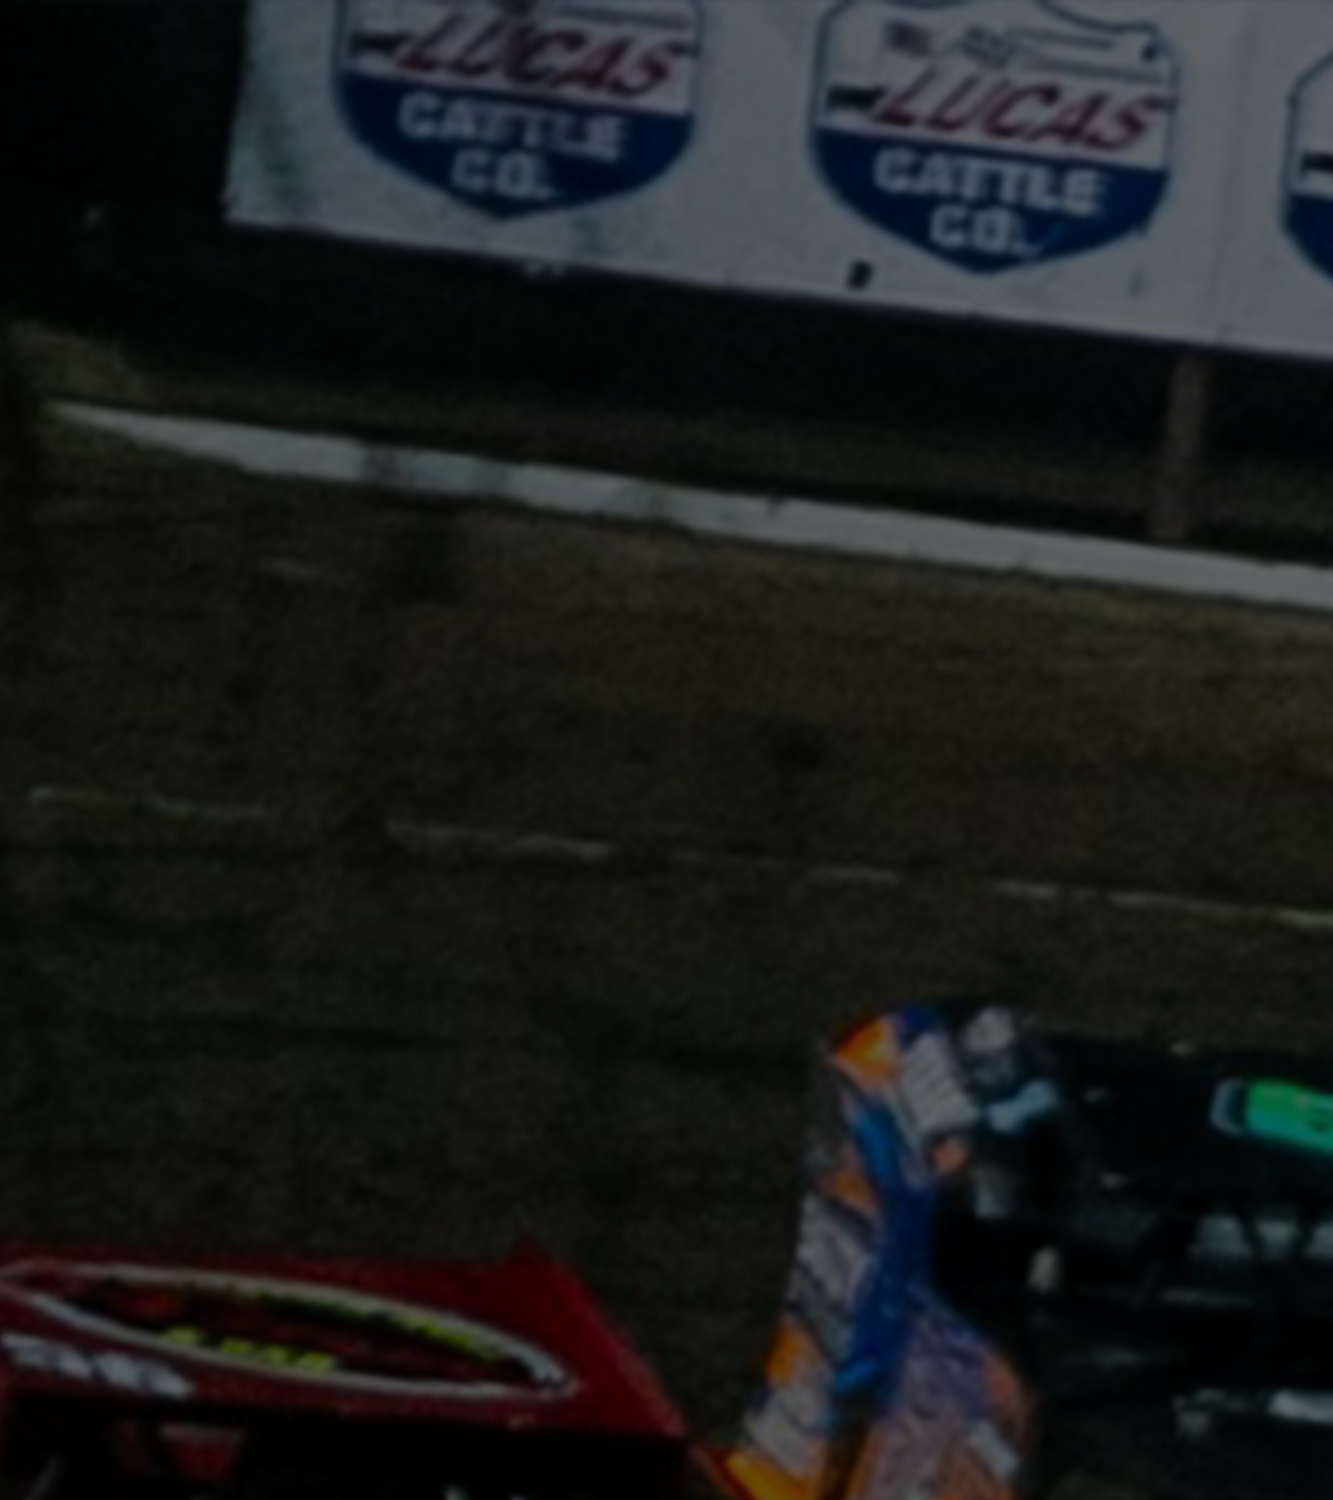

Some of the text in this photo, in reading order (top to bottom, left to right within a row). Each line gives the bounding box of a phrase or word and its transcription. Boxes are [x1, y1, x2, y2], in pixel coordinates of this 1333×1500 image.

[392, 10, 692, 97] LUCAS
[396, 90, 632, 164] CATTLE
[868, 64, 1172, 152] LUCAS
[448, 146, 562, 202] CO.
[870, 144, 1112, 219] CATTLE
